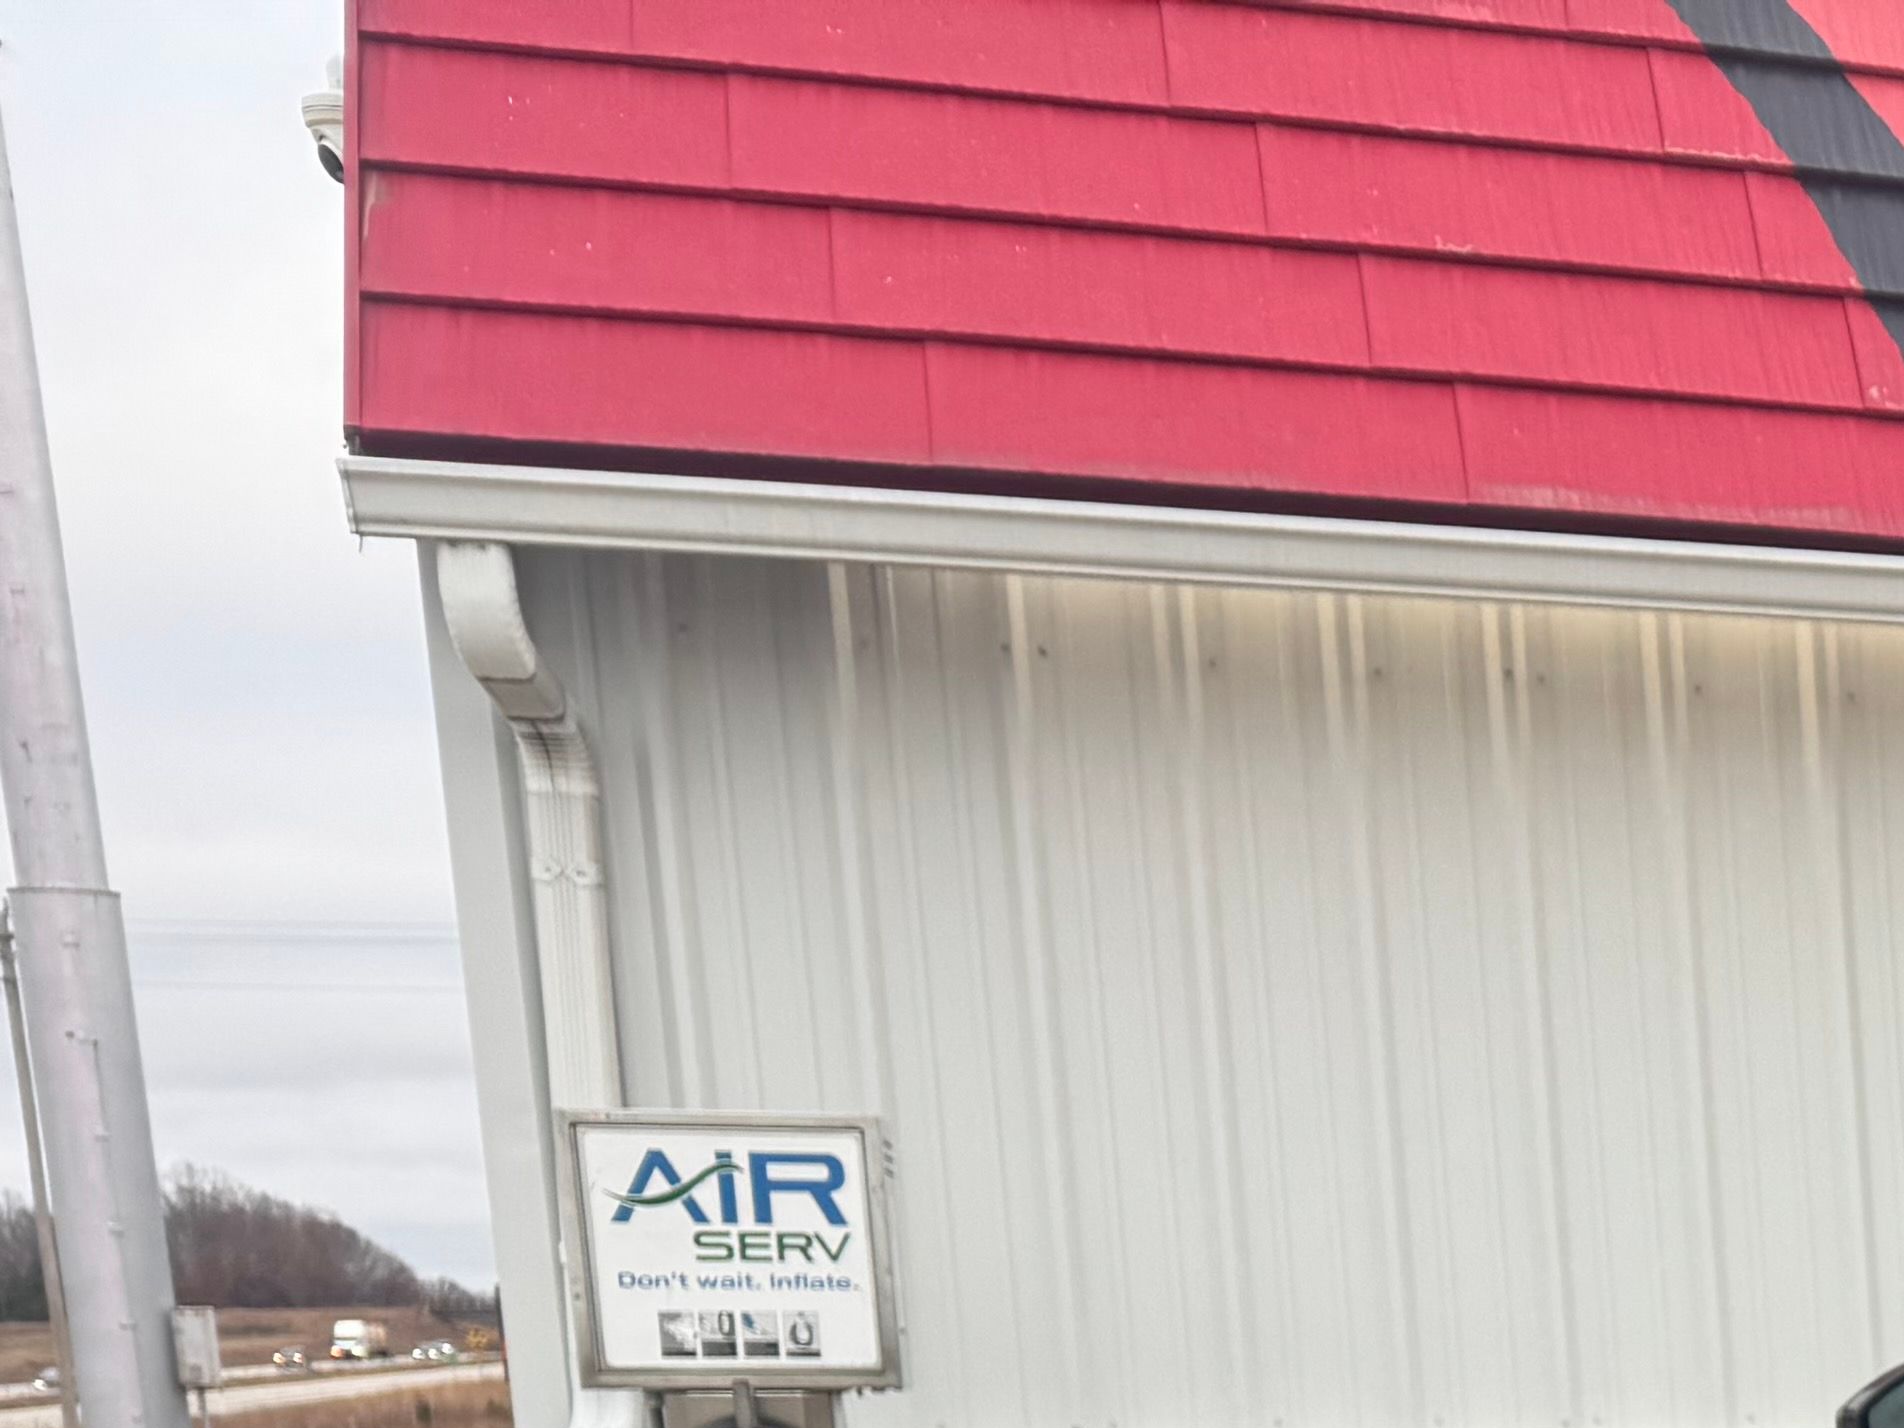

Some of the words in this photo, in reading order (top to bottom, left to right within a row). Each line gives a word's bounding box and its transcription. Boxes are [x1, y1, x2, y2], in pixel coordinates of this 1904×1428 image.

[693, 1230, 850, 1263] SERV
[617, 1271, 689, 1290] Don't
[696, 1272, 762, 1291] wait.
[770, 1273, 859, 1292] Inflate.
